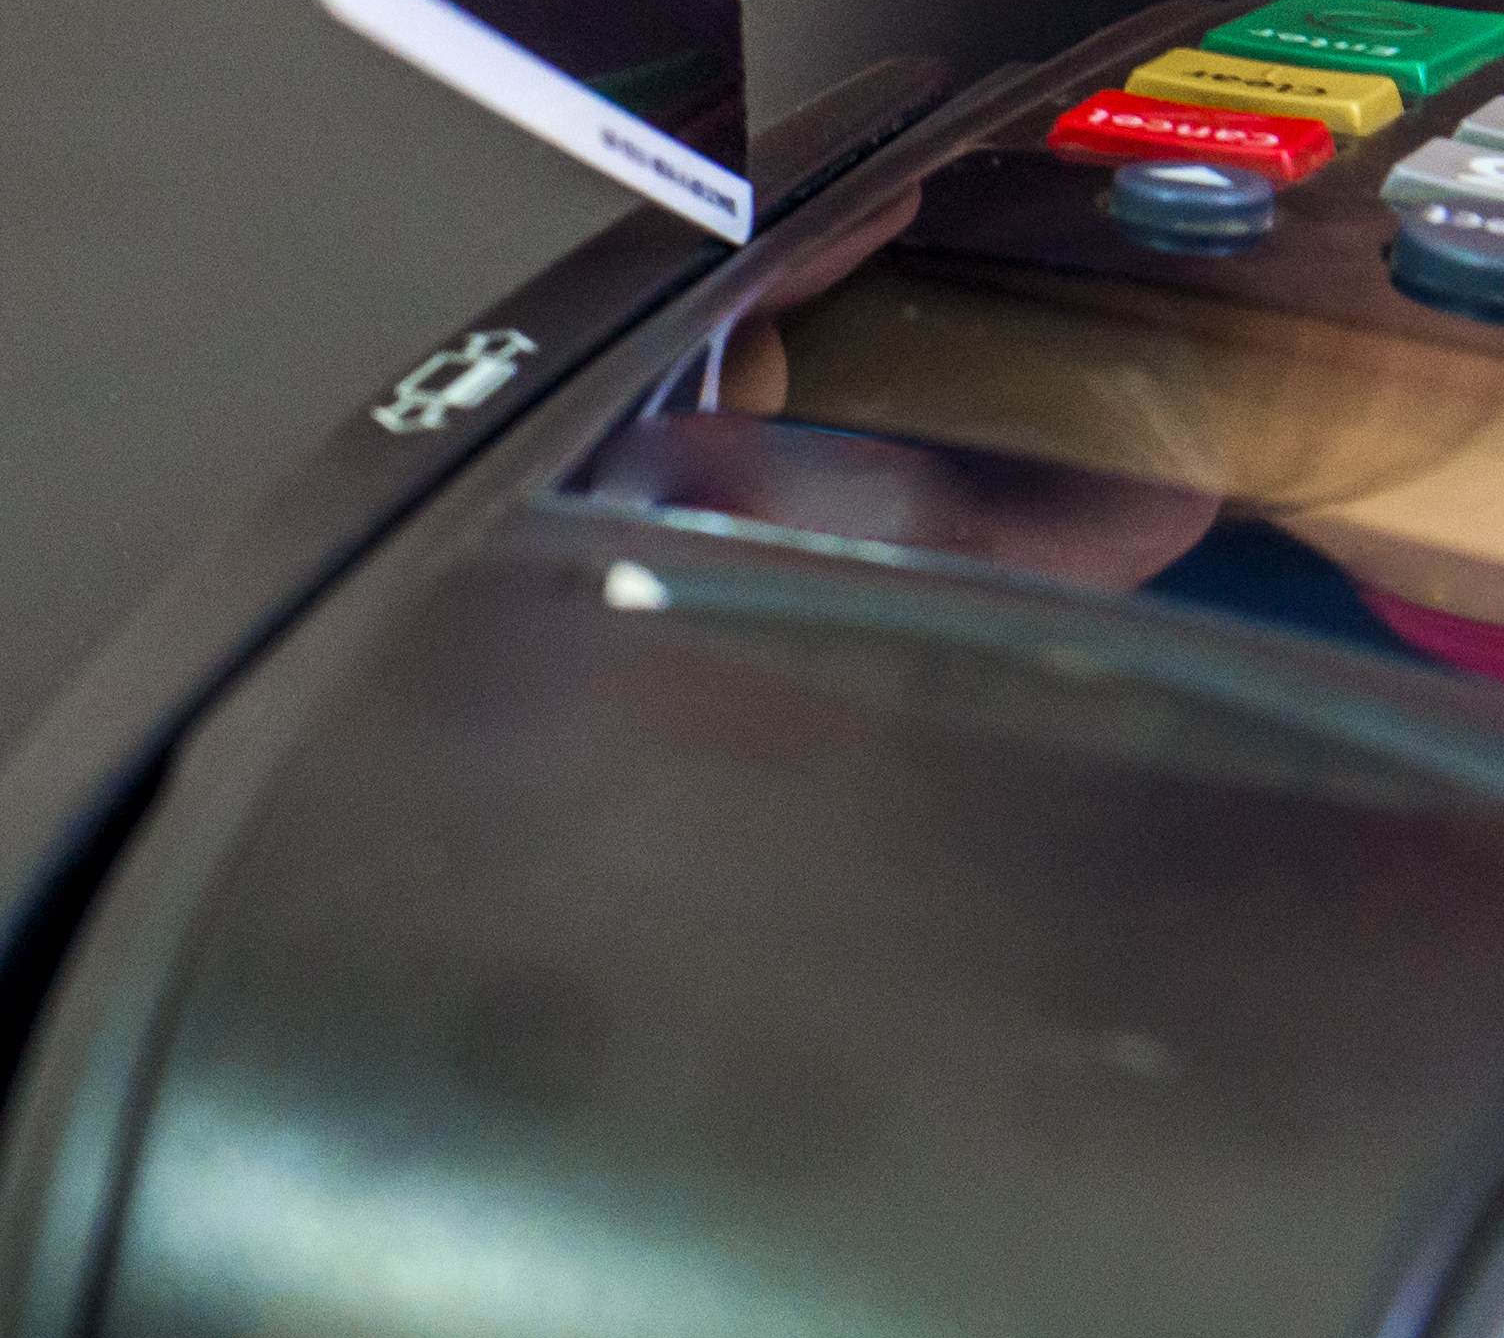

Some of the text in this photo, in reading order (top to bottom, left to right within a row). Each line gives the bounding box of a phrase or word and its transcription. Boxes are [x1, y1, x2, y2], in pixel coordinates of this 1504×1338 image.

[1248, 27, 1400, 58] Enter
[1179, 68, 1328, 98] Clear
[1088, 106, 1281, 148] Cancel
